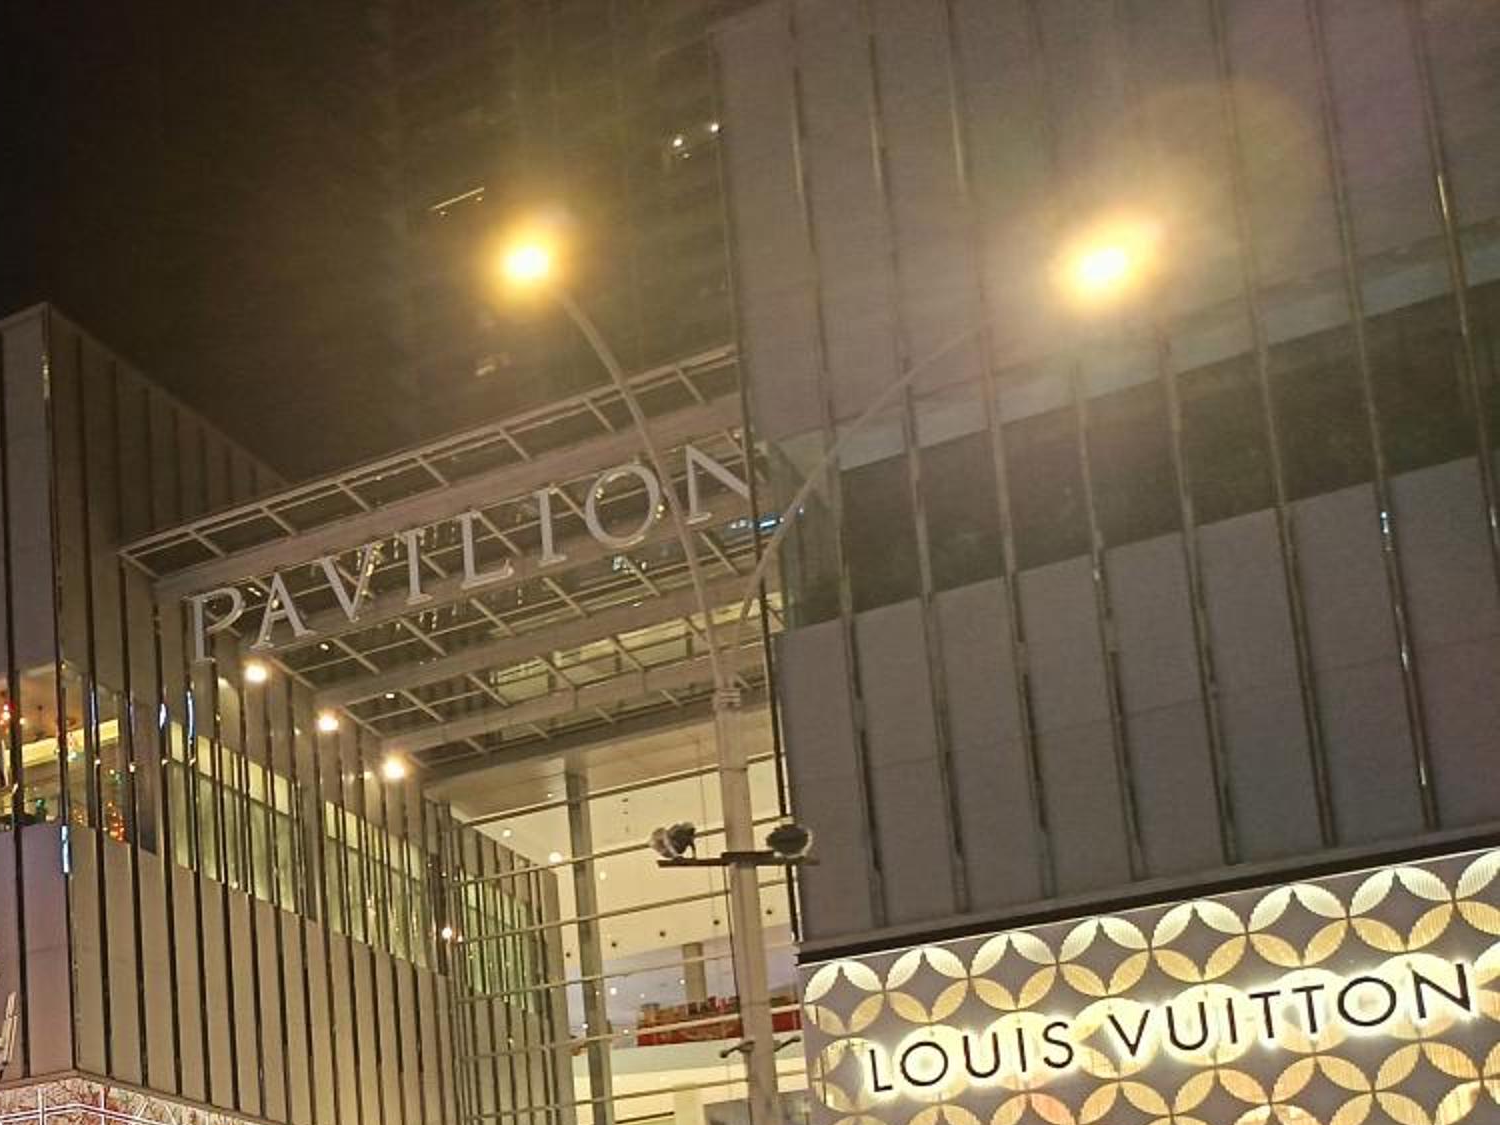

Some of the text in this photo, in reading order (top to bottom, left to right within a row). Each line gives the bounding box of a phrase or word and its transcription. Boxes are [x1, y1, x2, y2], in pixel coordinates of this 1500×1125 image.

[183, 445, 754, 663] PAVILION
[866, 962, 1473, 1093] LOUIS VUITTON
